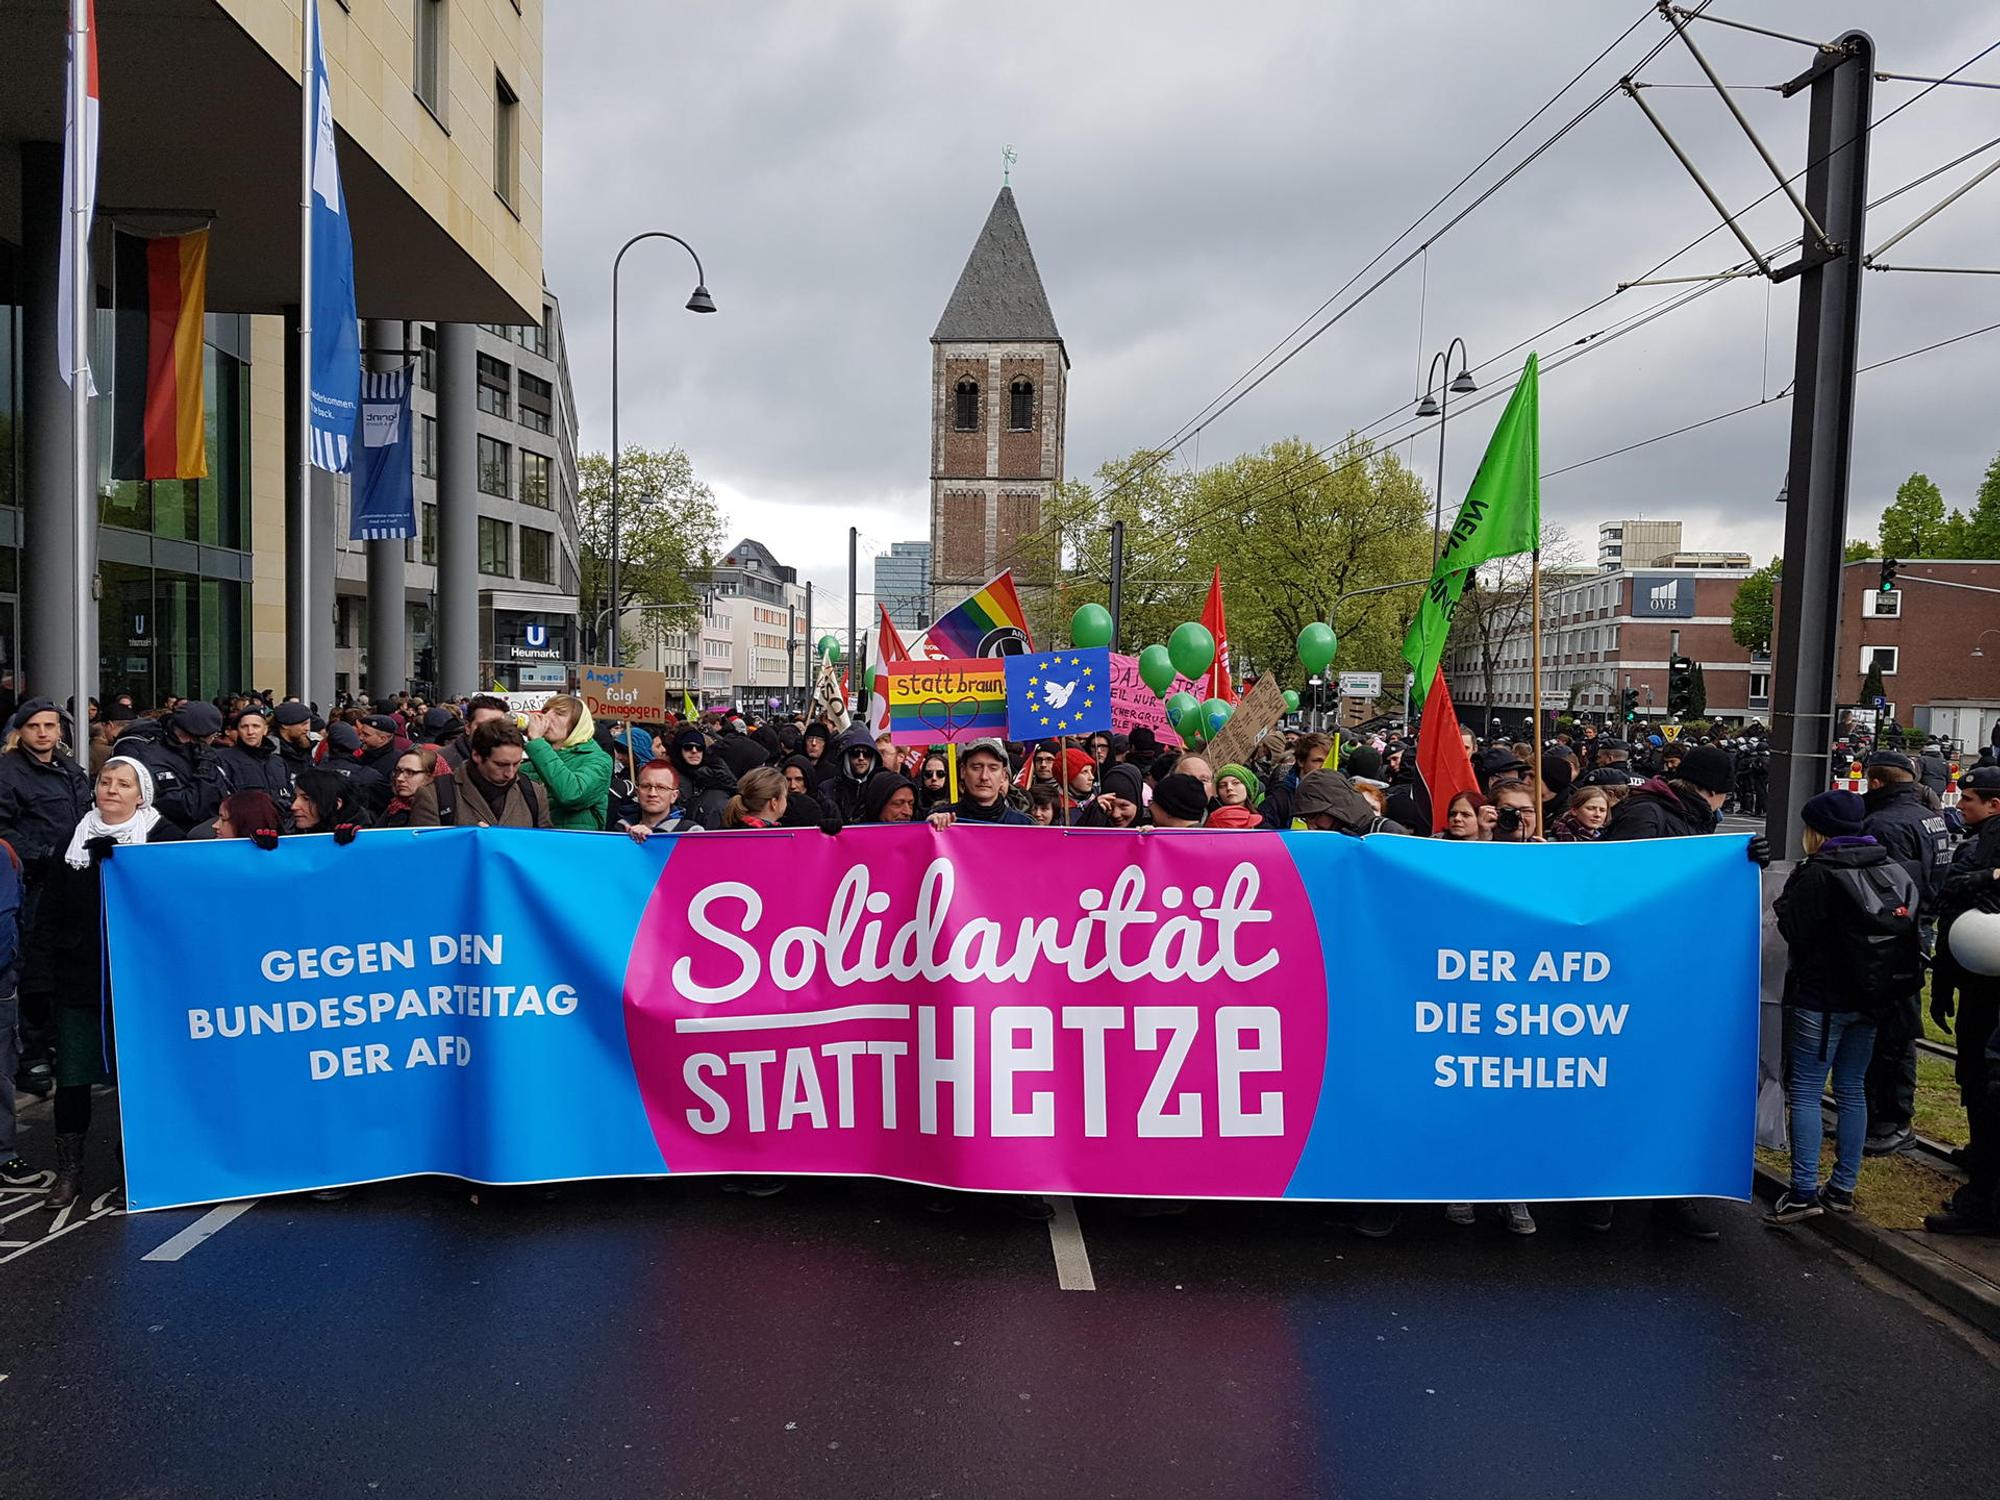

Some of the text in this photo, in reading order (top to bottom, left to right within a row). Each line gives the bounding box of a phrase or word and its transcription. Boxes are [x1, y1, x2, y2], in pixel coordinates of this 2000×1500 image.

[1650, 599, 1677, 610] OVB
[526, 626, 545, 646] U
[511, 647, 560, 659] Heumarkt
[586, 669, 624, 687] Angst
[897, 665, 1004, 696] statt braun
[587, 696, 661, 719] Demagogen
[606, 687, 640, 704] folgt
[1111, 687, 1157, 708] EIL NUR
[1111, 718, 1129, 729] BLE
[1666, 727, 1676, 738] 3
[671, 857, 1280, 1004] Solidarität
[260, 934, 502, 983] GEGEN DEN
[1437, 948, 1611, 982] DER AFD
[188, 984, 579, 1040] BUNDESPARTEITAG
[1415, 1001, 1630, 1037] DIE SHOW
[309, 1035, 472, 1081] DER AFD
[1434, 1054, 1608, 1089] STEHLEN
[682, 1040, 909, 1135] STATT
